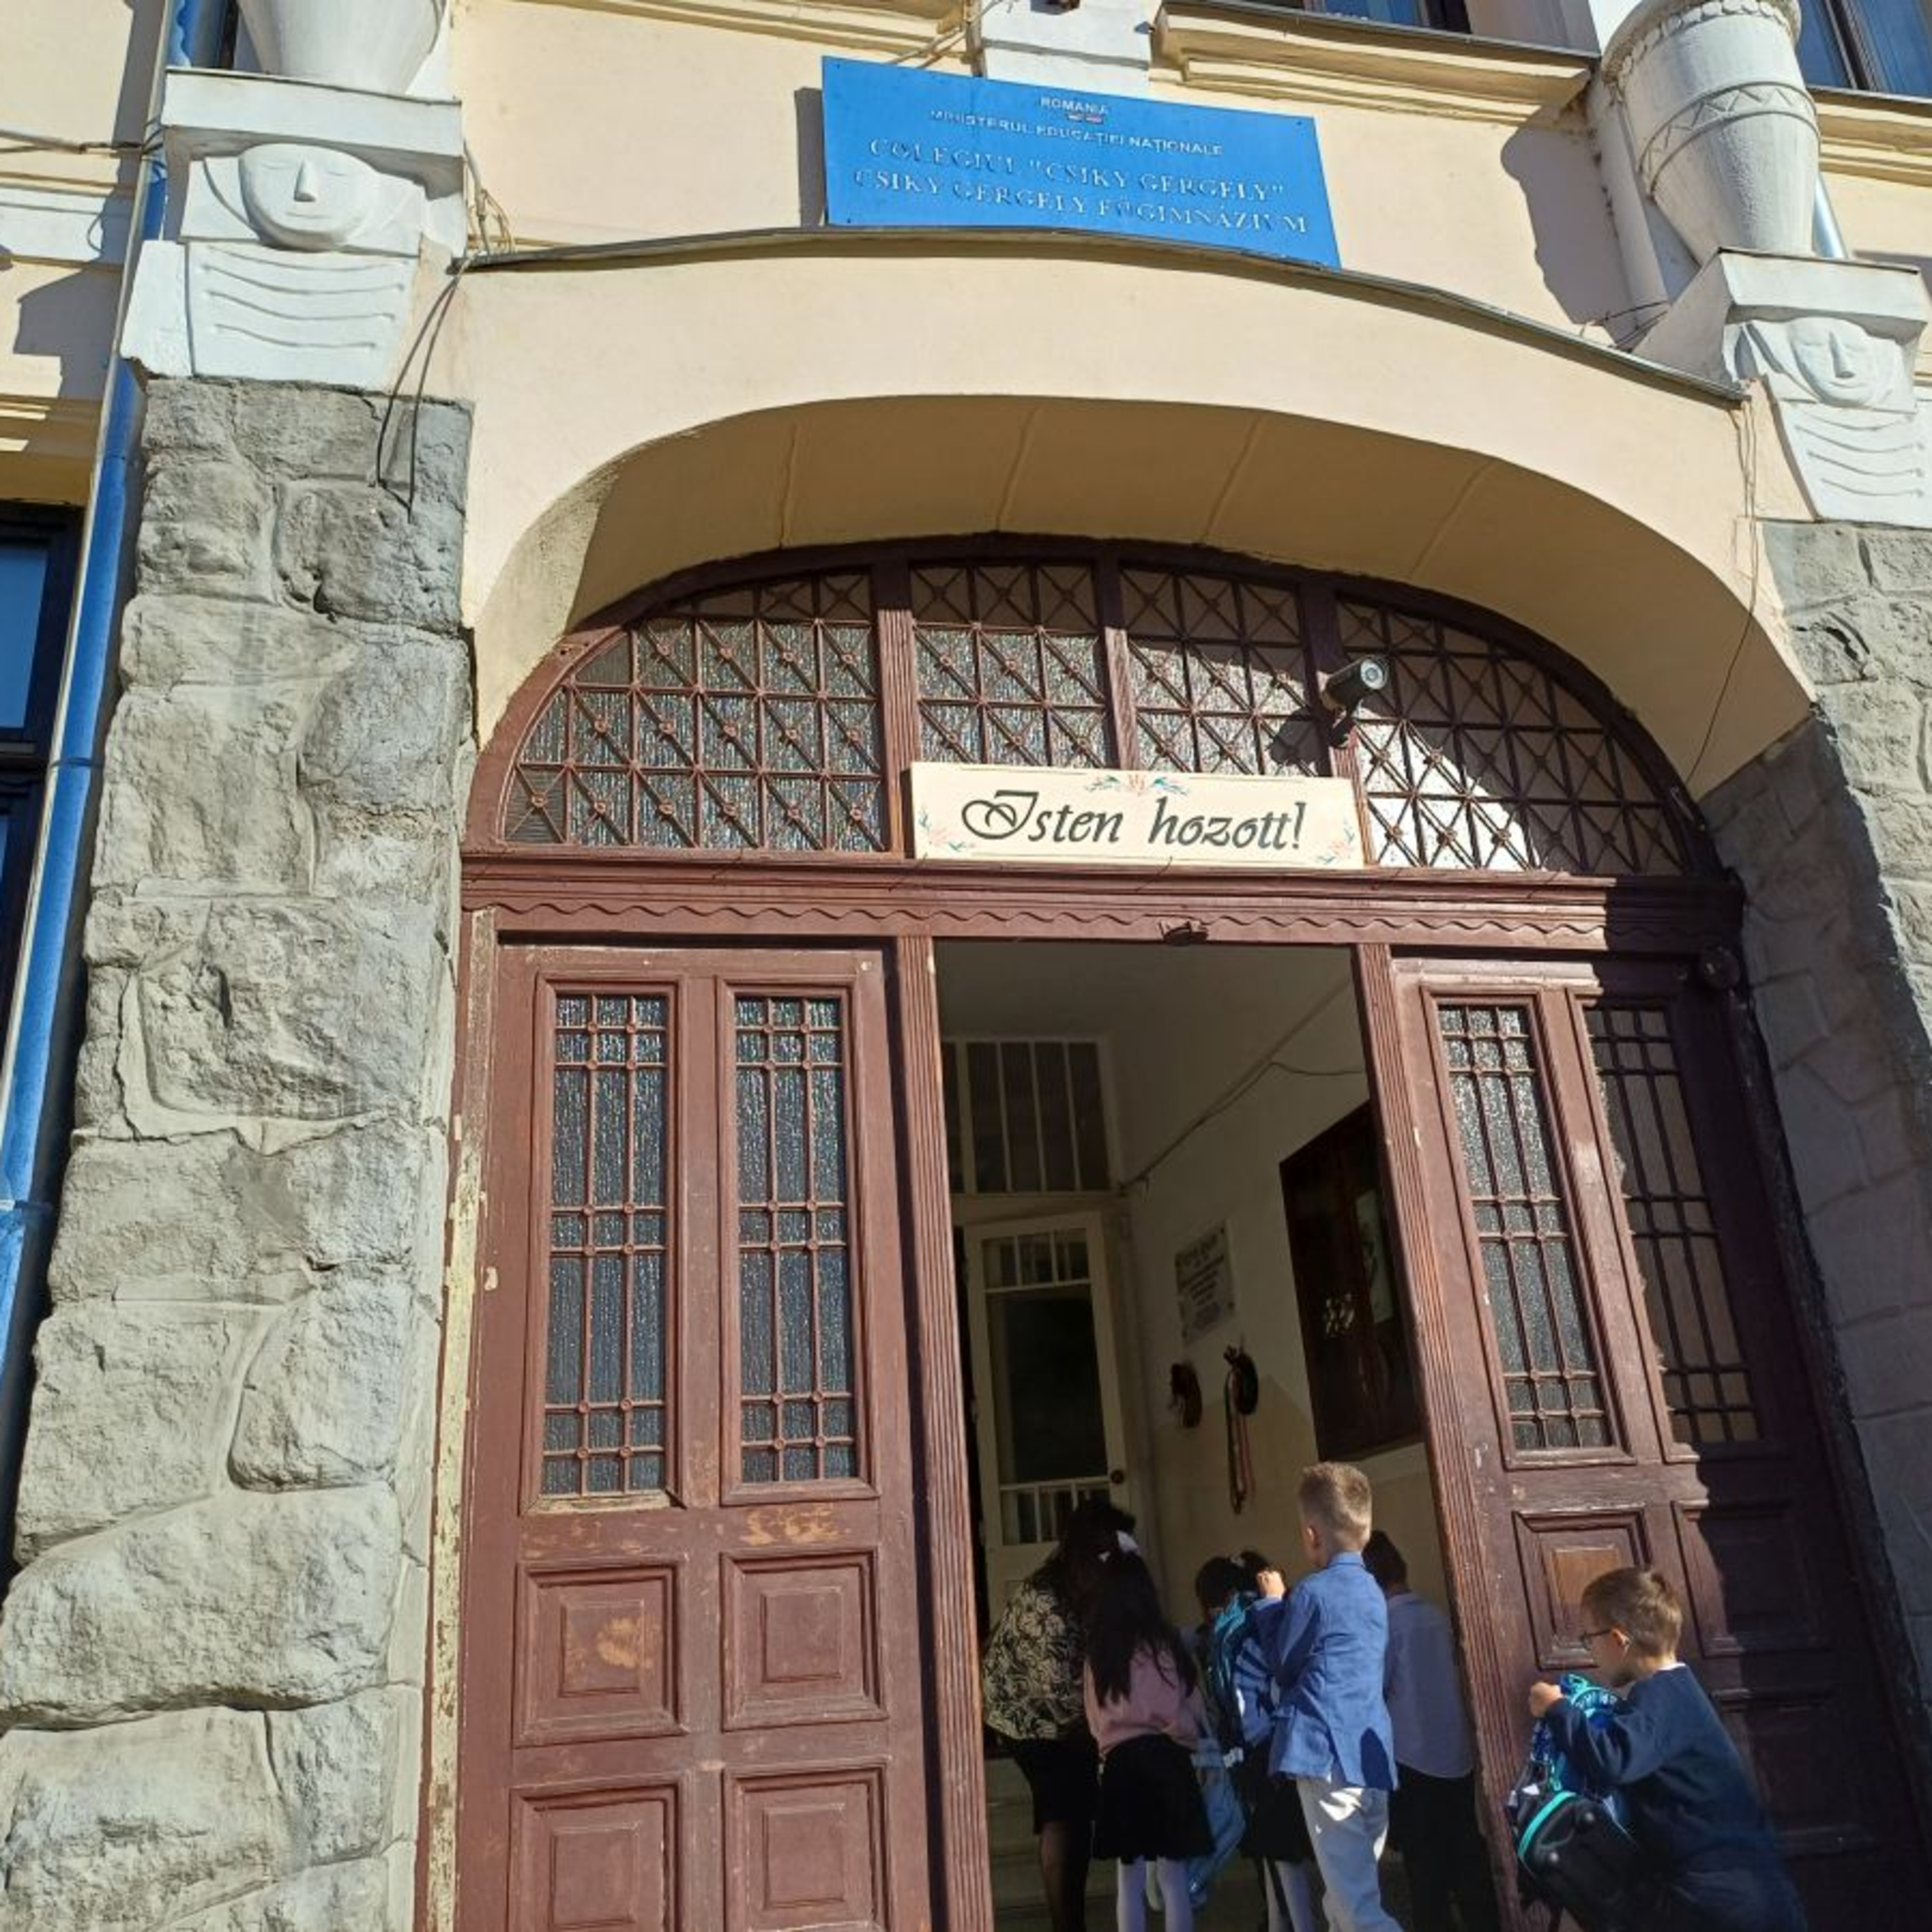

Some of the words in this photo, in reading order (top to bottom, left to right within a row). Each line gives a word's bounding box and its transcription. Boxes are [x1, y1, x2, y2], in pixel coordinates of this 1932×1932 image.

[931, 110, 1033, 134] MINISTERUL
[854, 169, 941, 194] CSIKY
[952, 181, 1088, 214] GERGELY
[869, 138, 1019, 175] COLEGIUL
[1030, 159, 1128, 188] "CSIKY
[1139, 173, 1283, 202] GERGELY"
[961, 790, 1123, 842] Isten
[1148, 797, 1307, 850] hozott!
